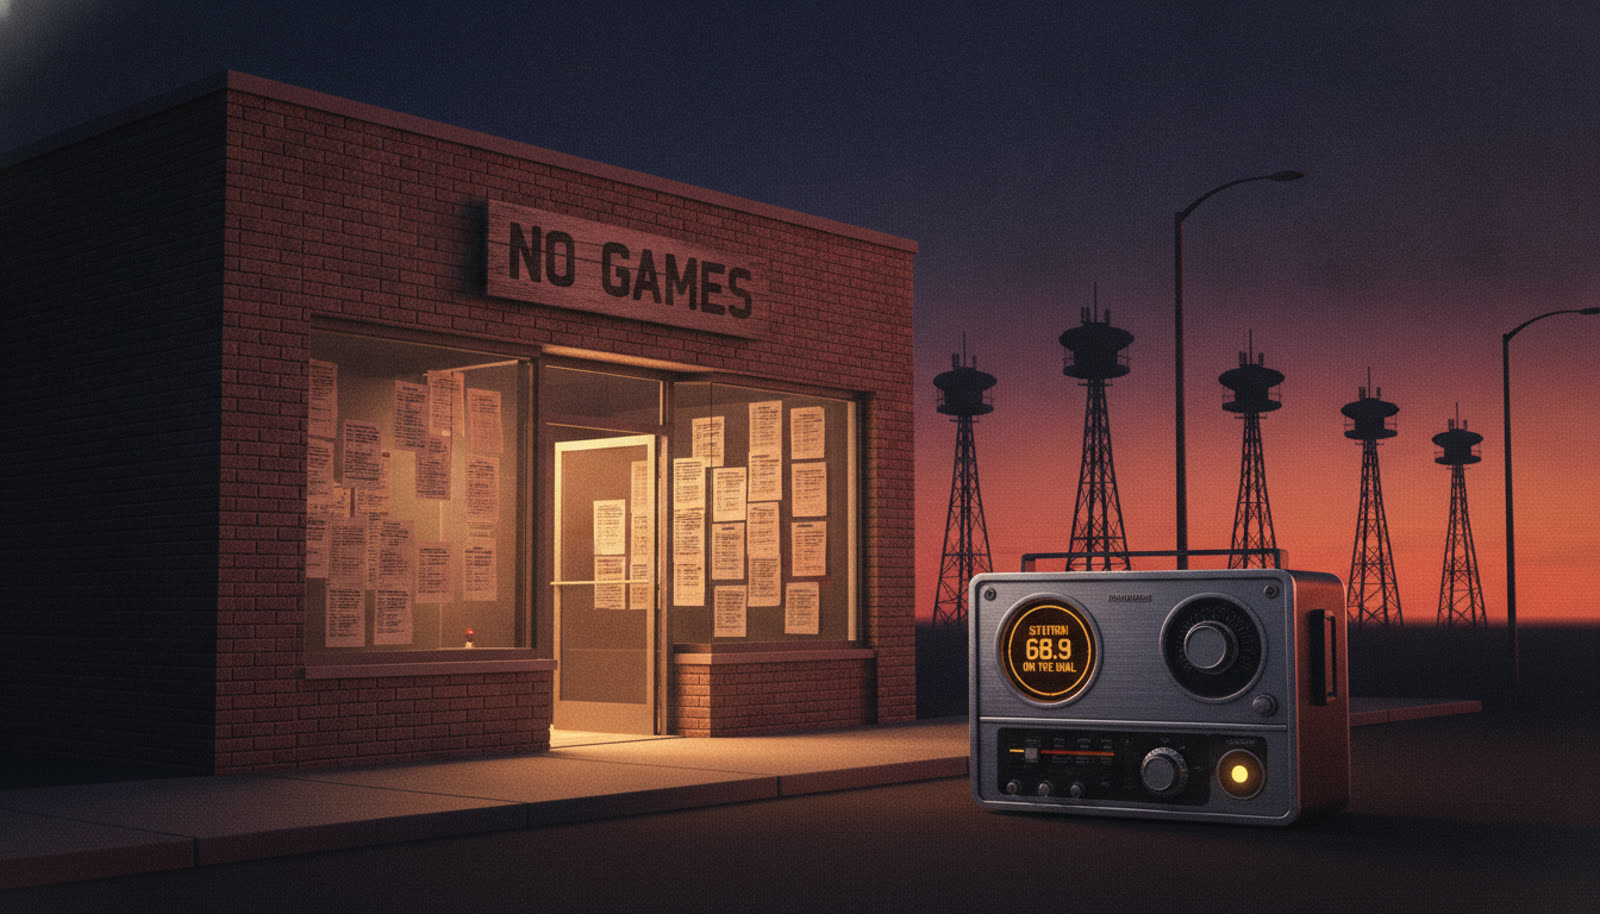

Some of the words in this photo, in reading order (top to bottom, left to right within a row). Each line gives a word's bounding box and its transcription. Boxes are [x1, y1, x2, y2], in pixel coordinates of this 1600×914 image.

[509, 221, 575, 288] NO
[601, 241, 752, 320] GAMES
[1025, 637, 1072, 660] 68.9
